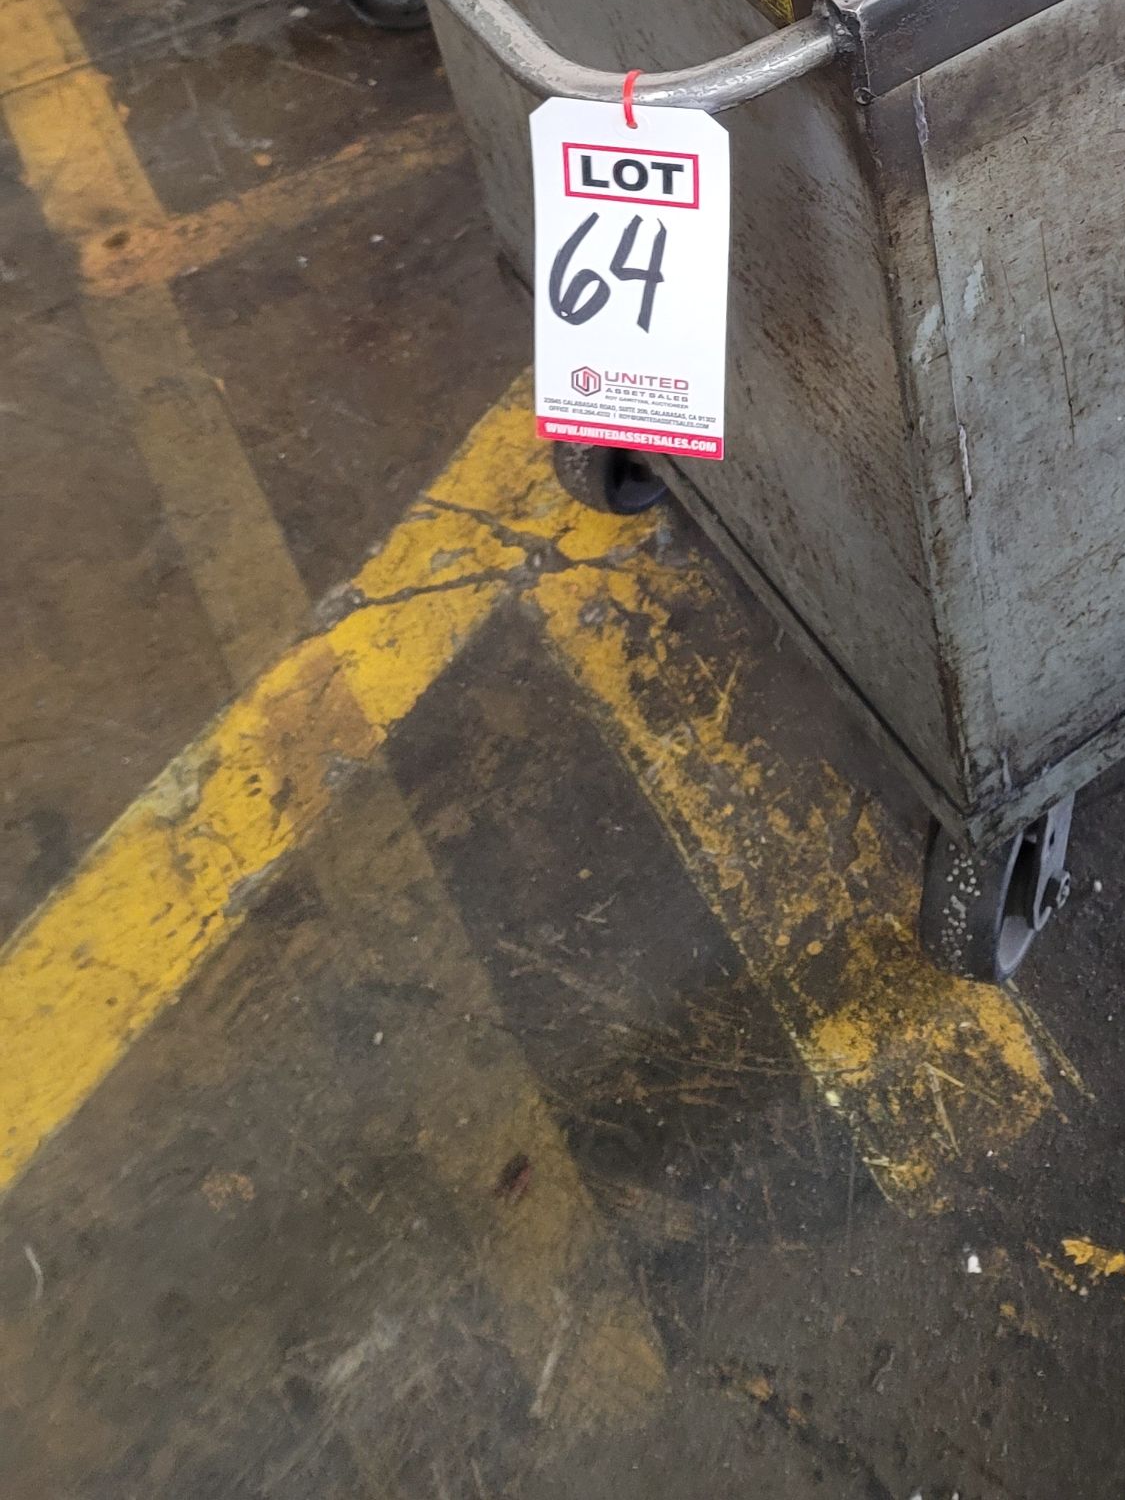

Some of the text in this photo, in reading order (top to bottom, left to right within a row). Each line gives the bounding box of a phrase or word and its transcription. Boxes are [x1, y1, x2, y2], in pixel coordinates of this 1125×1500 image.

[581, 155, 684, 195] LOT
[549, 212, 667, 333] 64
[604, 371, 689, 390] UNITED
[605, 387, 689, 403] ASSET SALES
[549, 405, 569, 413] OFFICE
[562, 399, 598, 409] CALABASAS
[618, 406, 636, 414] SUITE
[650, 410, 688, 420] CALABASAS,
[544, 422, 717, 452] WWW.UNITEDASSETSALES.COM
